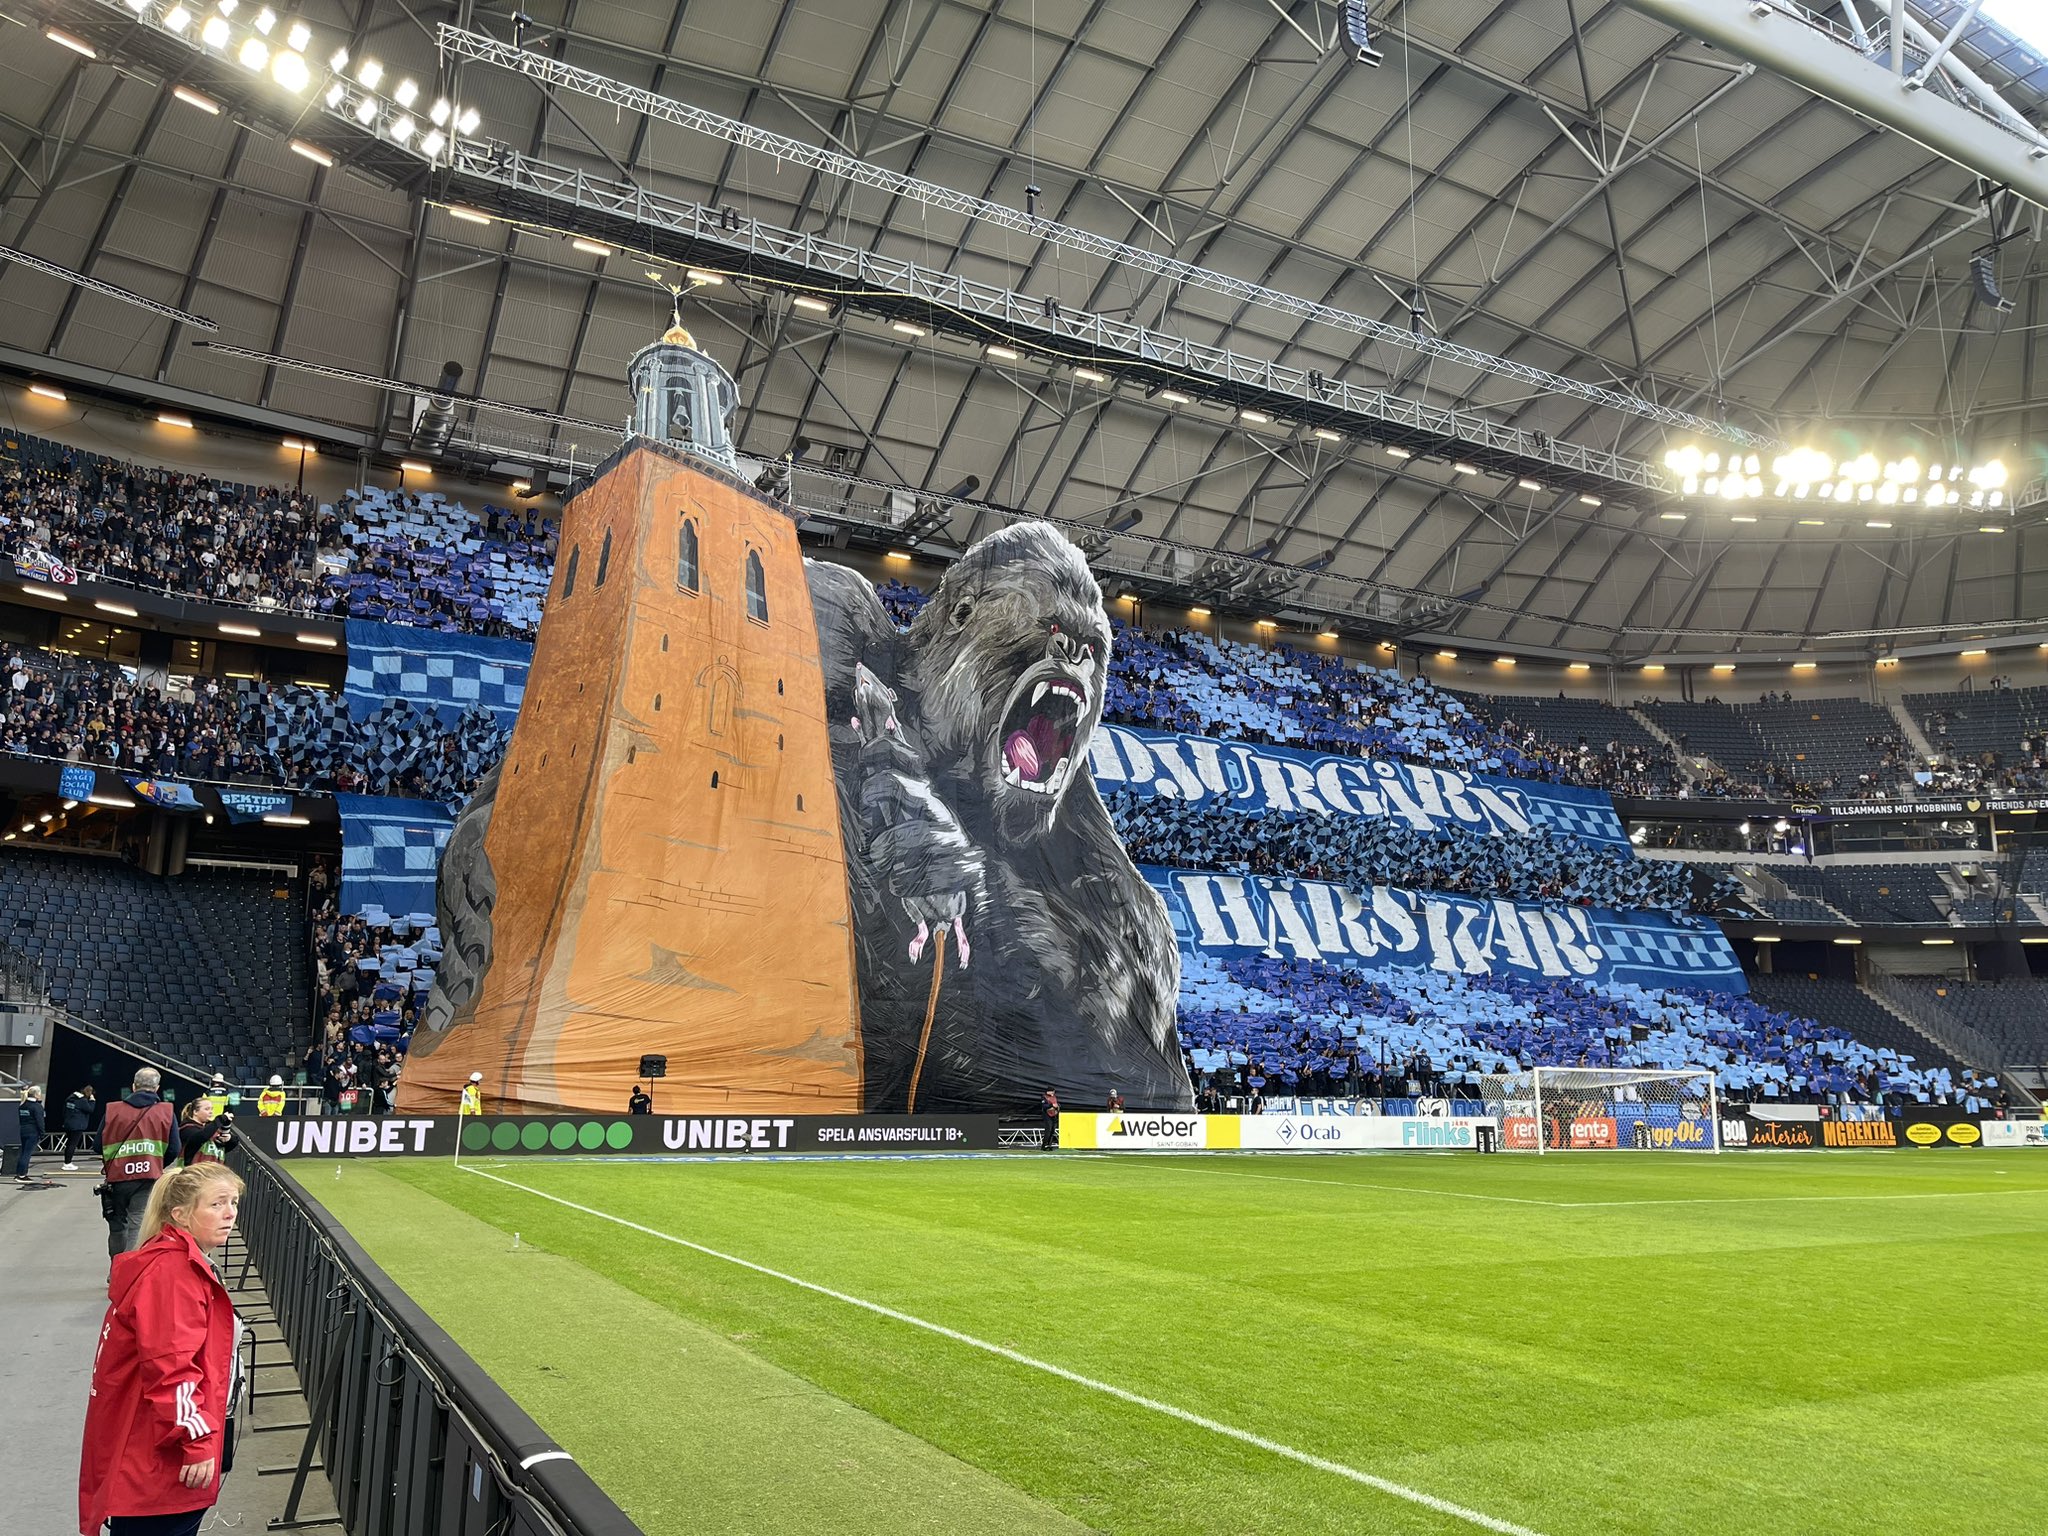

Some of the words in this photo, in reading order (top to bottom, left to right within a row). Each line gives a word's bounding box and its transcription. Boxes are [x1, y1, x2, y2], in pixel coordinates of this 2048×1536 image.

[63, 788, 84, 798] CLUB
[222, 794, 287, 805] SEKTION
[236, 803, 273, 814] STIM
[1795, 806, 1817, 814] friends
[1830, 805, 1893, 816] TILLSAMMANS
[1895, 804, 1913, 814] MOT
[1915, 803, 1963, 813] MOBBNING
[1986, 800, 2025, 811] FRIENDS
[1178, 874, 1603, 977] HÄRSKAR!
[340, 1092, 356, 1101] 103
[662, 1118, 794, 1150] UNIBET
[1126, 1115, 1198, 1137] weber
[1300, 1123, 1341, 1140] Ocab
[1402, 1121, 1471, 1146] Flinks
[1513, 1122, 1538, 1138] ren
[1570, 1121, 1609, 1138] renta
[1722, 1120, 1748, 1141] BOA
[1751, 1121, 1813, 1146] interiör
[275, 1119, 435, 1155] UNIBET
[818, 1127, 855, 1142] SPELA
[858, 1127, 942, 1141] ANSVARSFULLT
[945, 1127, 963, 1141] 18+
[118, 1140, 155, 1156] PHOTO
[124, 1160, 150, 1175] 083
